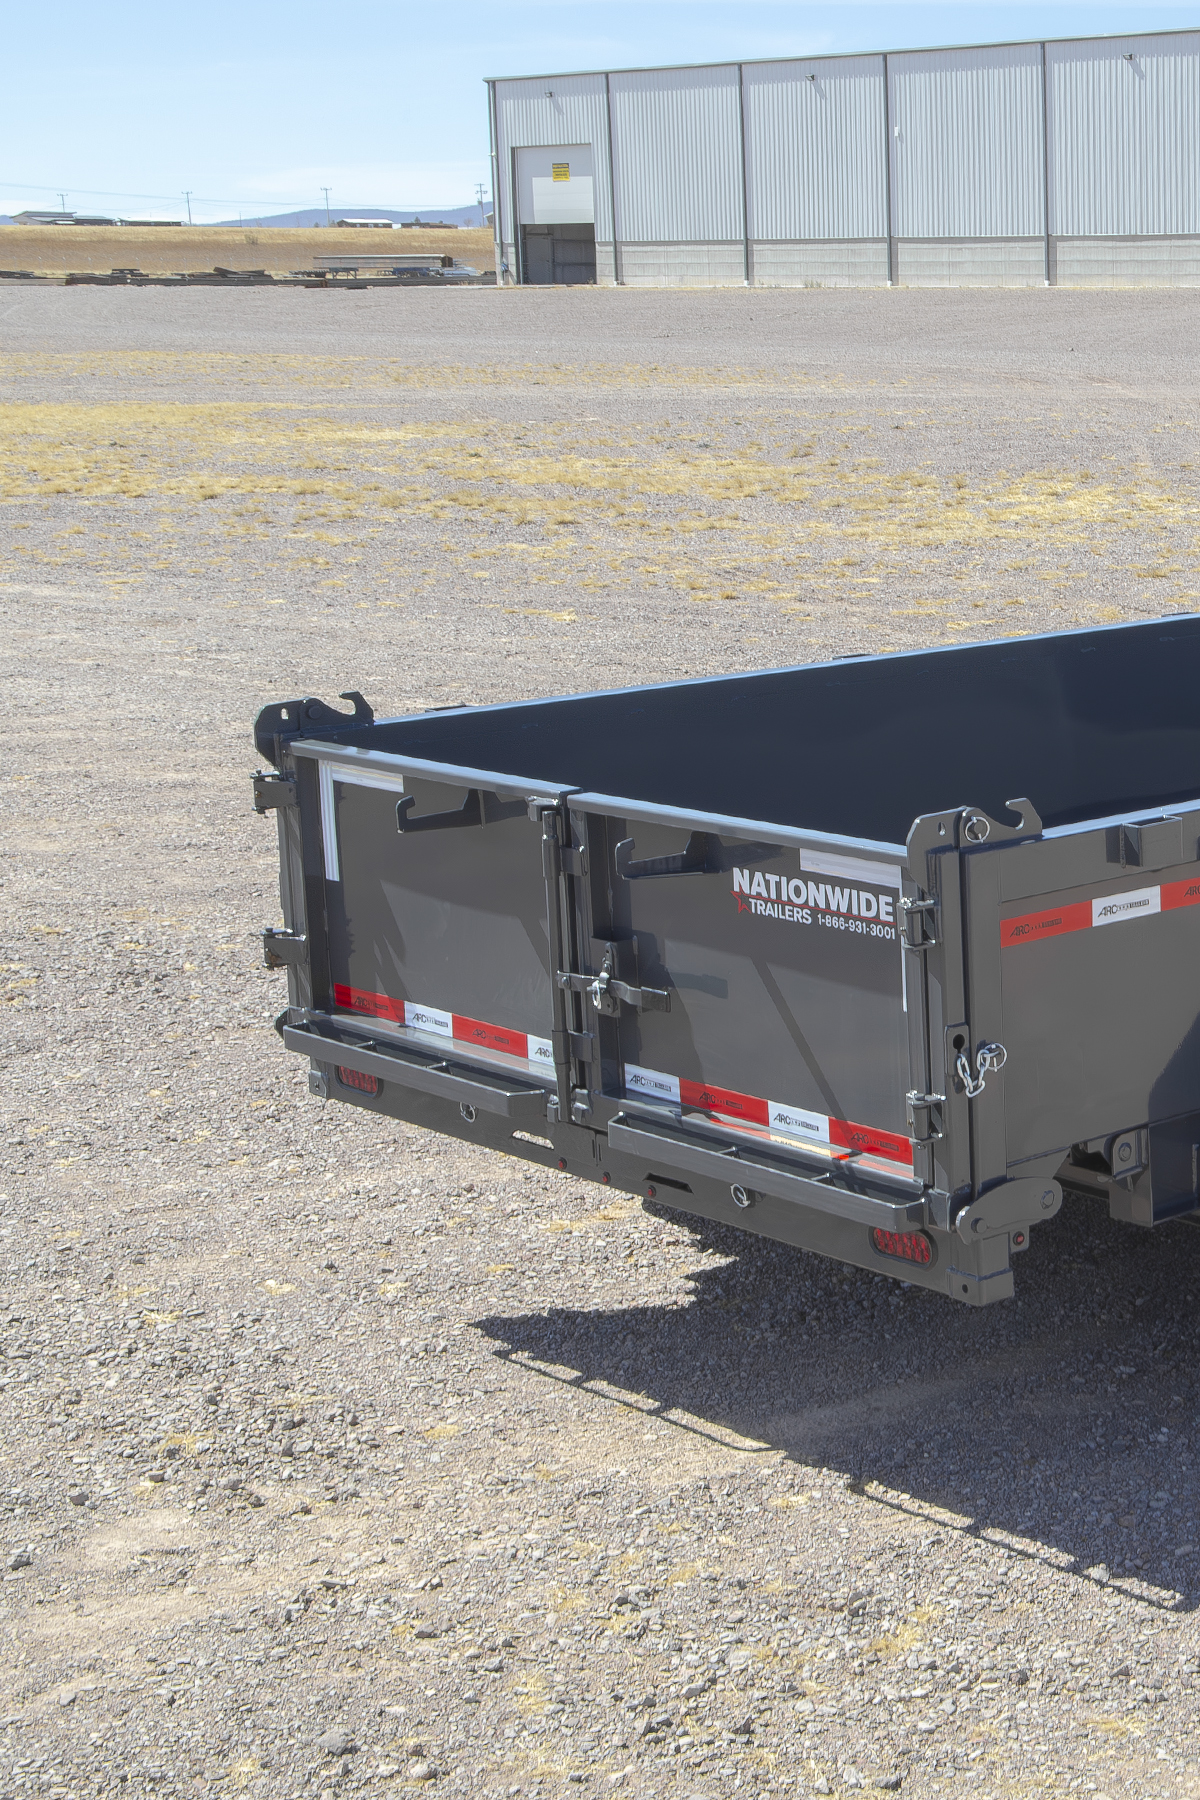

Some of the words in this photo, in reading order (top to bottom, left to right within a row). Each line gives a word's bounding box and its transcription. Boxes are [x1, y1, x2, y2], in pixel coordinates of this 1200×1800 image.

[732, 867, 893, 922] NATIONWIDE
[1098, 904, 1118, 917] ARC
[749, 898, 812, 925] TRAILERS
[817, 914, 896, 940] 1-866-931-3001
[1009, 923, 1030, 938] ARC
[412, 1012, 426, 1023] ARC
[629, 1074, 646, 1087] ARC
[699, 1091, 716, 1104] ARC
[773, 1112, 791, 1126] ARC
[851, 1132, 869, 1145] ARC
